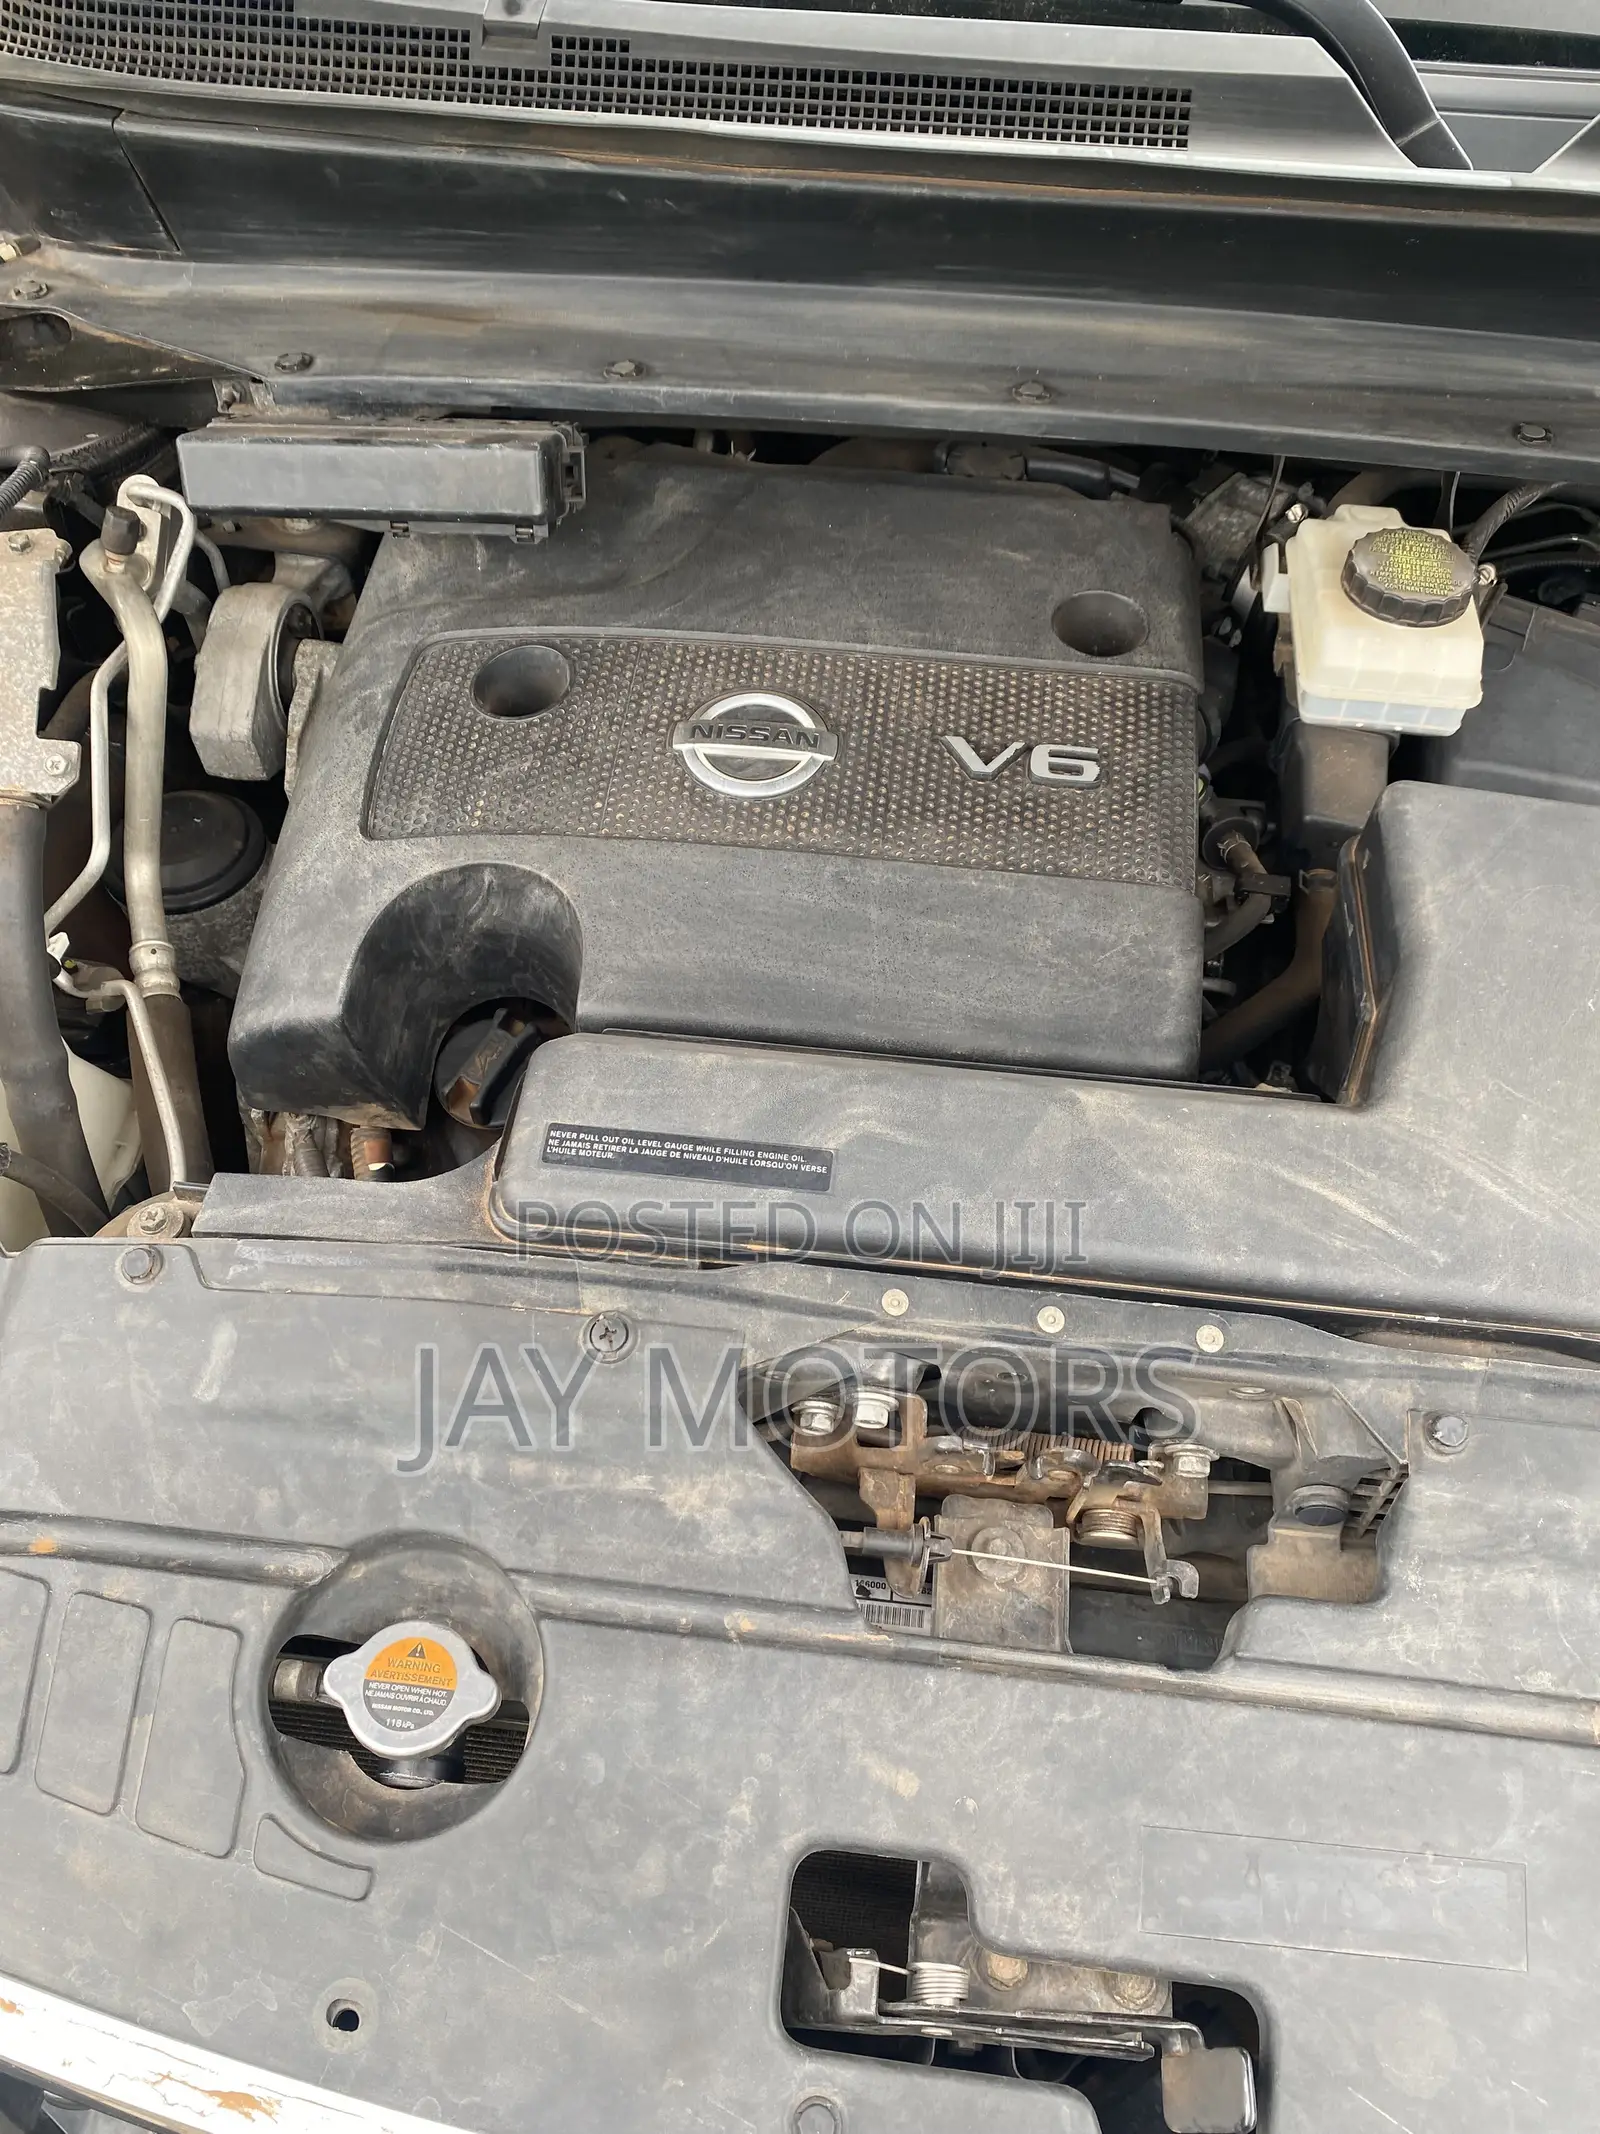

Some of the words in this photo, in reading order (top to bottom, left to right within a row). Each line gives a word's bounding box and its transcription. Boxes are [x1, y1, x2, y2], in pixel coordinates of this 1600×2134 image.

[689, 723, 821, 748] NISSAN
[941, 735, 1102, 788] V6
[546, 1147, 576, 1155] L'HUILE
[578, 1150, 615, 1159] MOTEUR.
[550, 1130, 578, 1140] NEVER
[580, 1133, 600, 1142] PULL
[602, 1135, 620, 1144] OUT
[622, 1137, 635, 1145] OIL
[637, 1139, 662, 1148] LEVEL
[664, 1141, 694, 1151] GAUGE
[696, 1144, 722, 1154] WHILE
[724, 1148, 755, 1158] FILLING
[757, 1151, 789, 1161] ENGINE
[562, 1140, 590, 1149] JAMAIS
[593, 1144, 627, 1153] RETIRER
[641, 1148, 668, 1157] JAUGE
[683, 1152, 712, 1162] NIVEAU
[716, 1155, 748, 1165] D'HUILE
[750, 1160, 798, 1170] LORSQU'ON
[801, 1164, 828, 1174] VERSE
[388, 1658, 441, 1673] WARNING
[370, 1670, 453, 1687] AVERTISSEMENT
[369, 1682, 390, 1690] NEVER
[391, 1684, 410, 1692] OPEN
[411, 1686, 431, 1695] WHEN
[396, 1694, 419, 1702] OUVRIR
